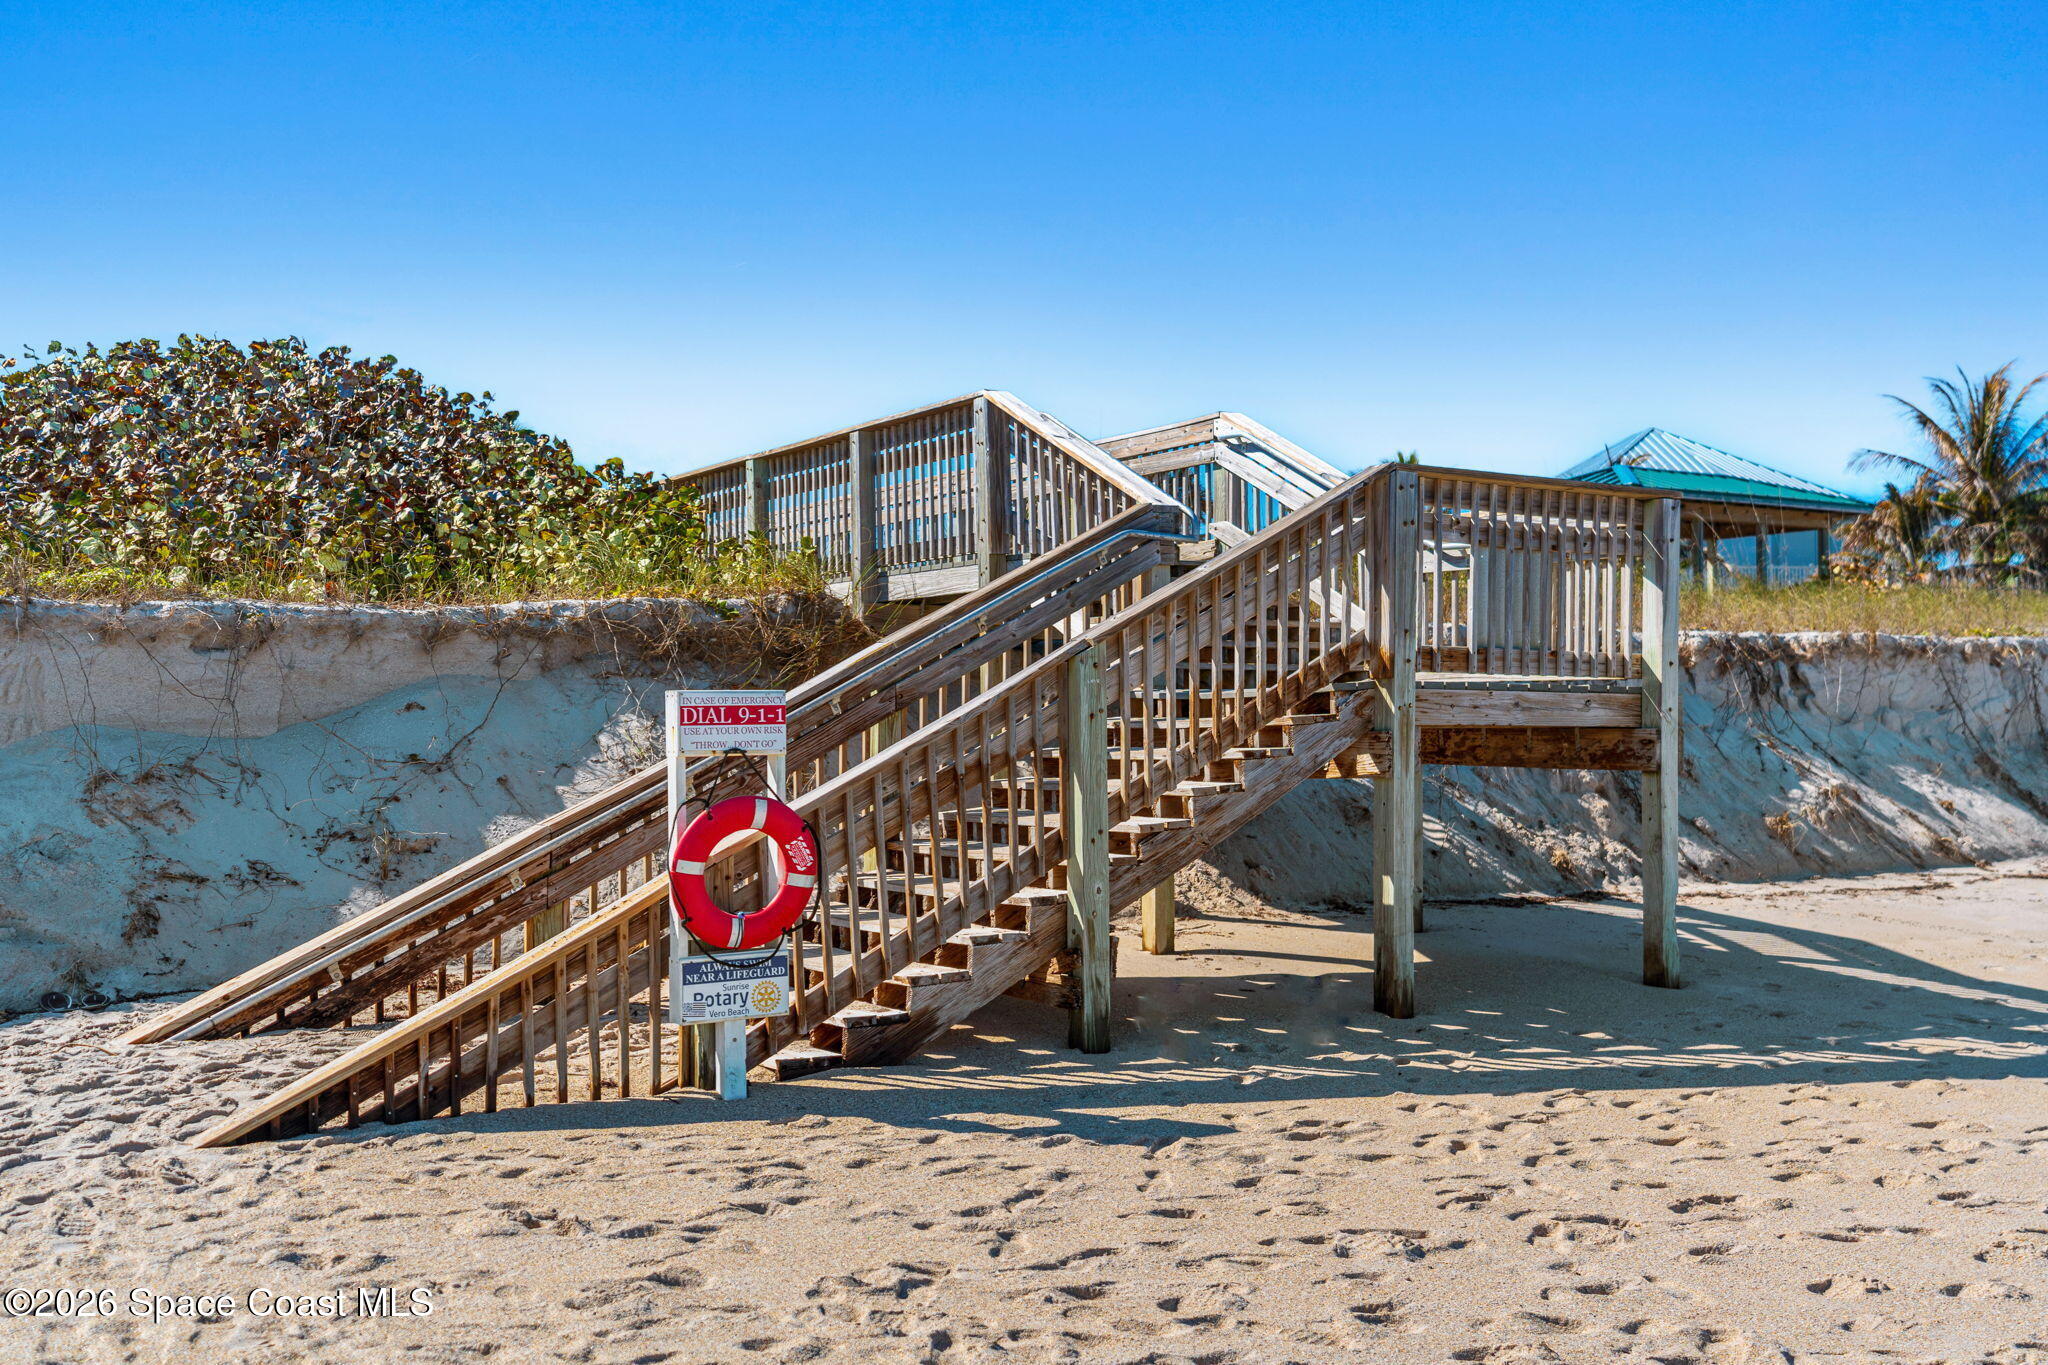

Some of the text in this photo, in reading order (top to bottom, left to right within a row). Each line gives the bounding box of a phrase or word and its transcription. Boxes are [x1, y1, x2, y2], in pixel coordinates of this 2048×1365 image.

[682, 696, 784, 705] IN CASE OF EMERGENCY
[682, 706, 785, 724] DIAL 9-1-1
[683, 726, 784, 735] USE AT YOUR OWN RISK
[685, 966, 785, 983] NEAR A LIFEGUARD
[722, 983, 750, 991] Sunrise
[709, 1007, 750, 1018] Vero Beach
